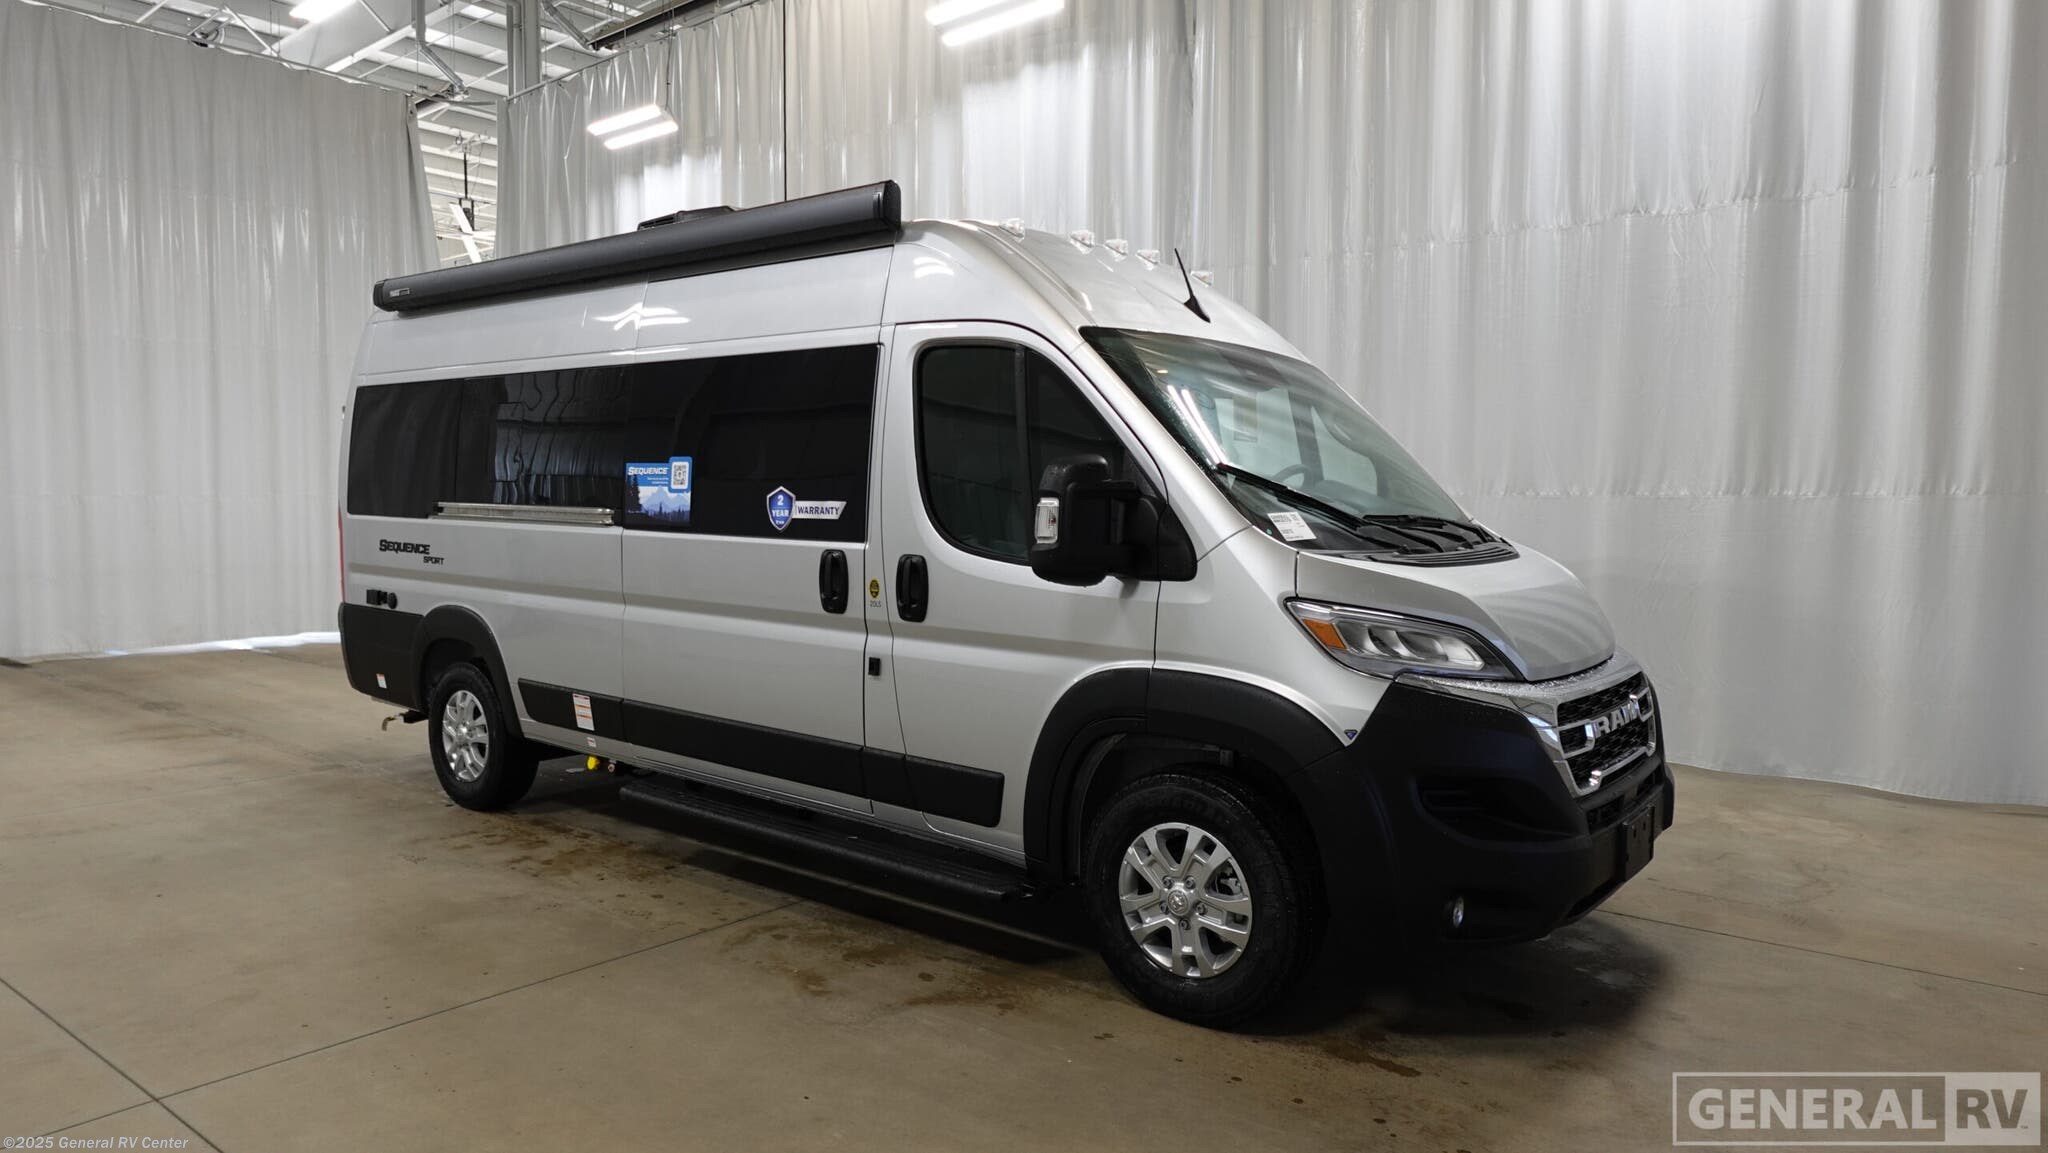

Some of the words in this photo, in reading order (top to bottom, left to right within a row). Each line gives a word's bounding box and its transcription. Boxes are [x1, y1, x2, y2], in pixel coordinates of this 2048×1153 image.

[627, 466, 669, 476] SEQUENCE
[777, 495, 784, 506] 2
[771, 509, 790, 517] YEAR
[797, 506, 840, 515] WARRANTY
[379, 539, 431, 555] SEQUENCE
[423, 556, 444, 565] SPORT
[1591, 699, 1641, 738] RAM
